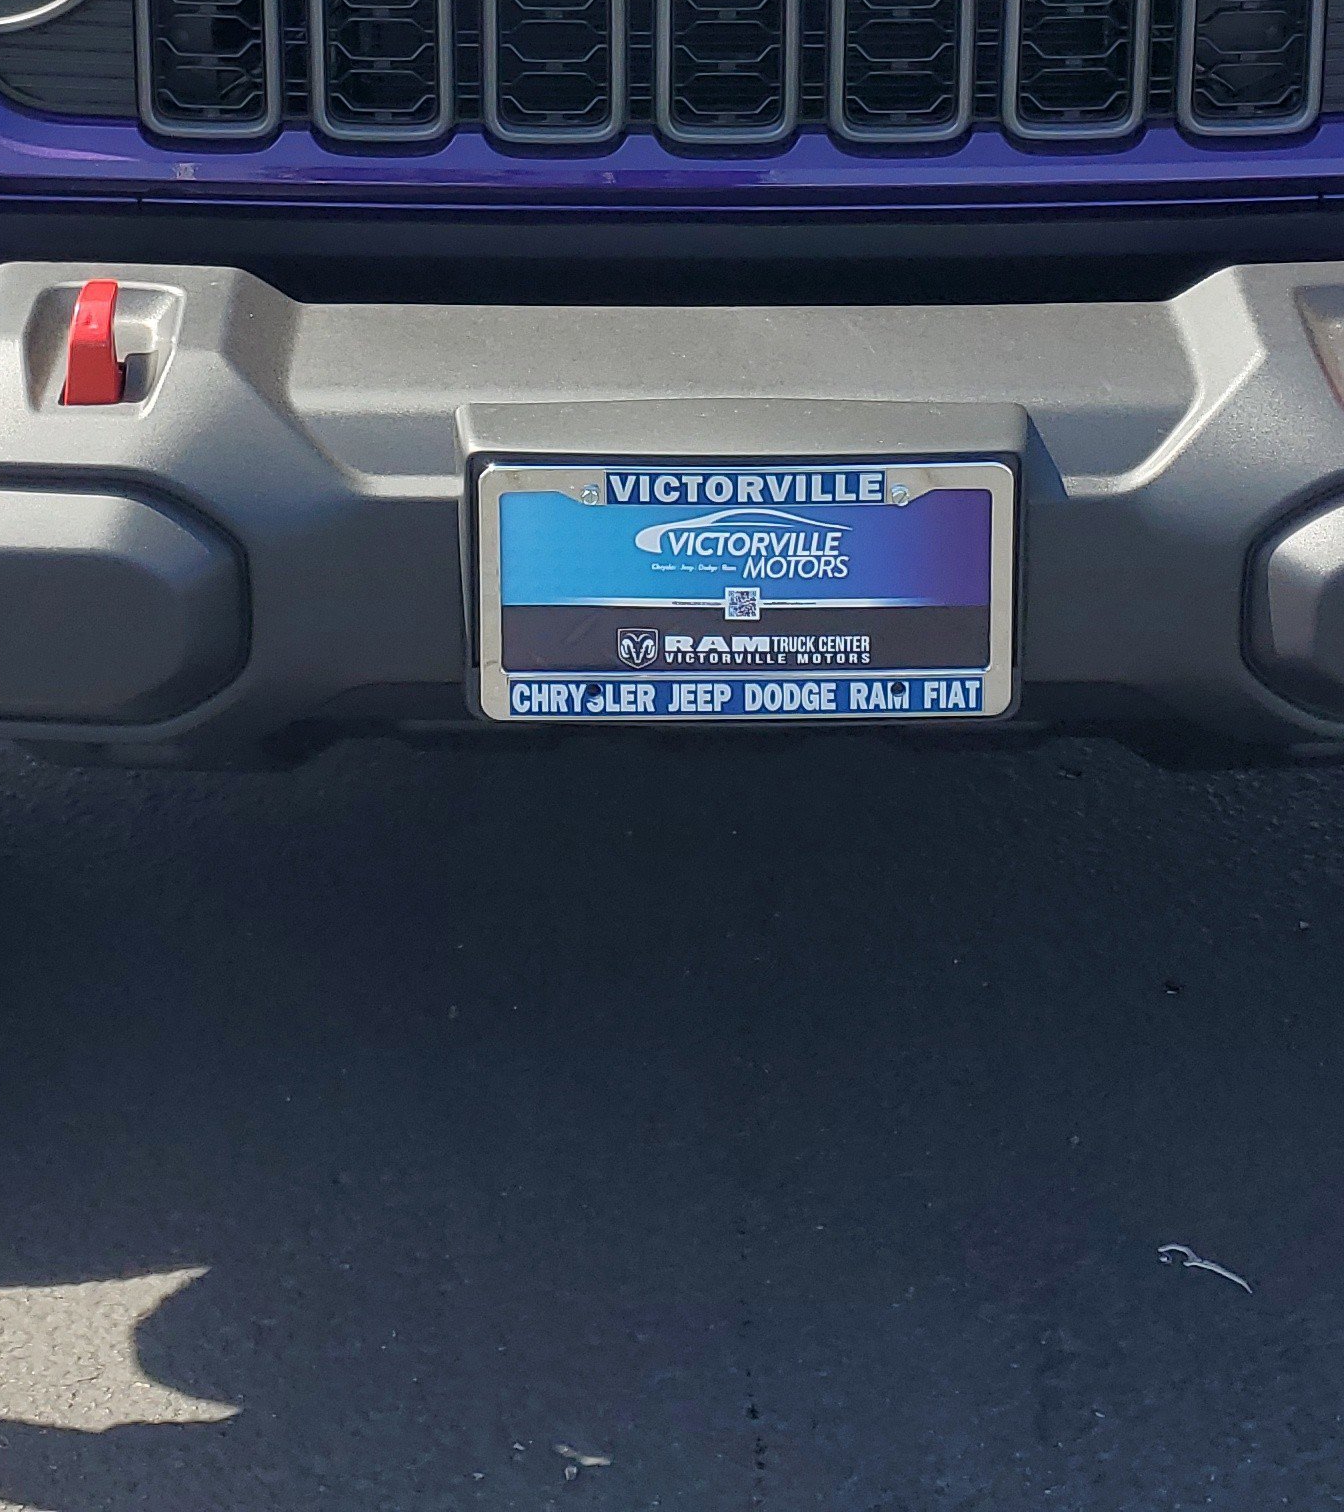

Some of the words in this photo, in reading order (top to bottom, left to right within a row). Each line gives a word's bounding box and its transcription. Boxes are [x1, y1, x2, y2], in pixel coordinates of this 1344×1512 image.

[609, 474, 882, 503] VICTORVILLE
[668, 532, 842, 556] VICTORVILLE
[742, 556, 849, 579] MOTORS
[665, 636, 770, 652] RAM
[771, 636, 816, 652] TRUCK
[818, 636, 870, 652] CENTER
[665, 653, 787, 664] VICTORVILLE
[797, 653, 871, 664] MOTORS
[668, 683, 732, 712] JEEP
[744, 683, 837, 711] DODGE
[849, 682, 910, 710] RAM
[923, 681, 980, 709] FIAT
